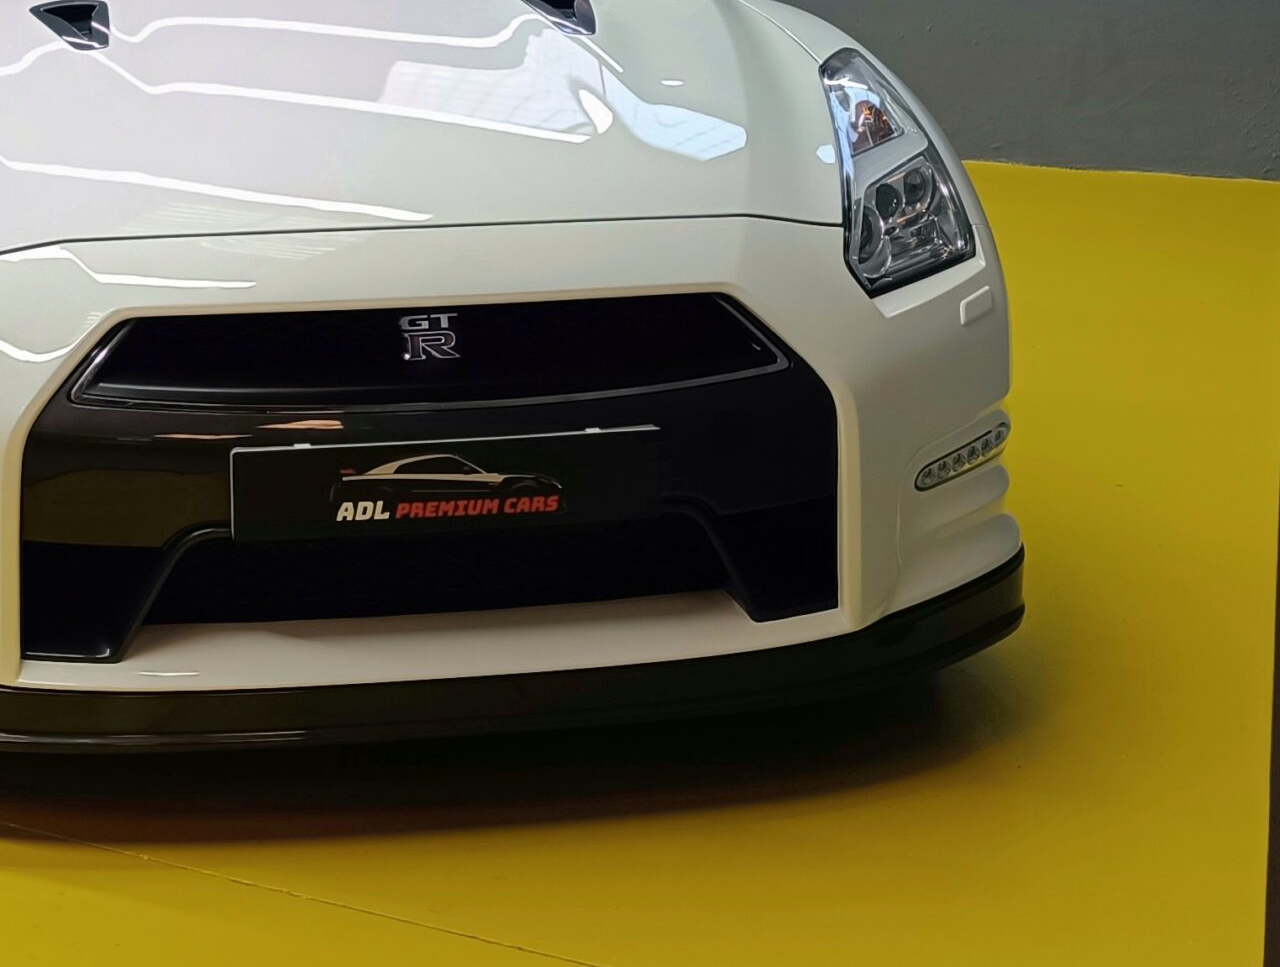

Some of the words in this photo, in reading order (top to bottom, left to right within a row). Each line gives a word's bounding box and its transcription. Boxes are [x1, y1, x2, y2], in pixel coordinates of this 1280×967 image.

[399, 312, 458, 330] GT
[403, 330, 461, 361] R
[336, 501, 390, 521] ADL
[396, 499, 499, 519] PREMIUM
[504, 496, 559, 514] CARS
